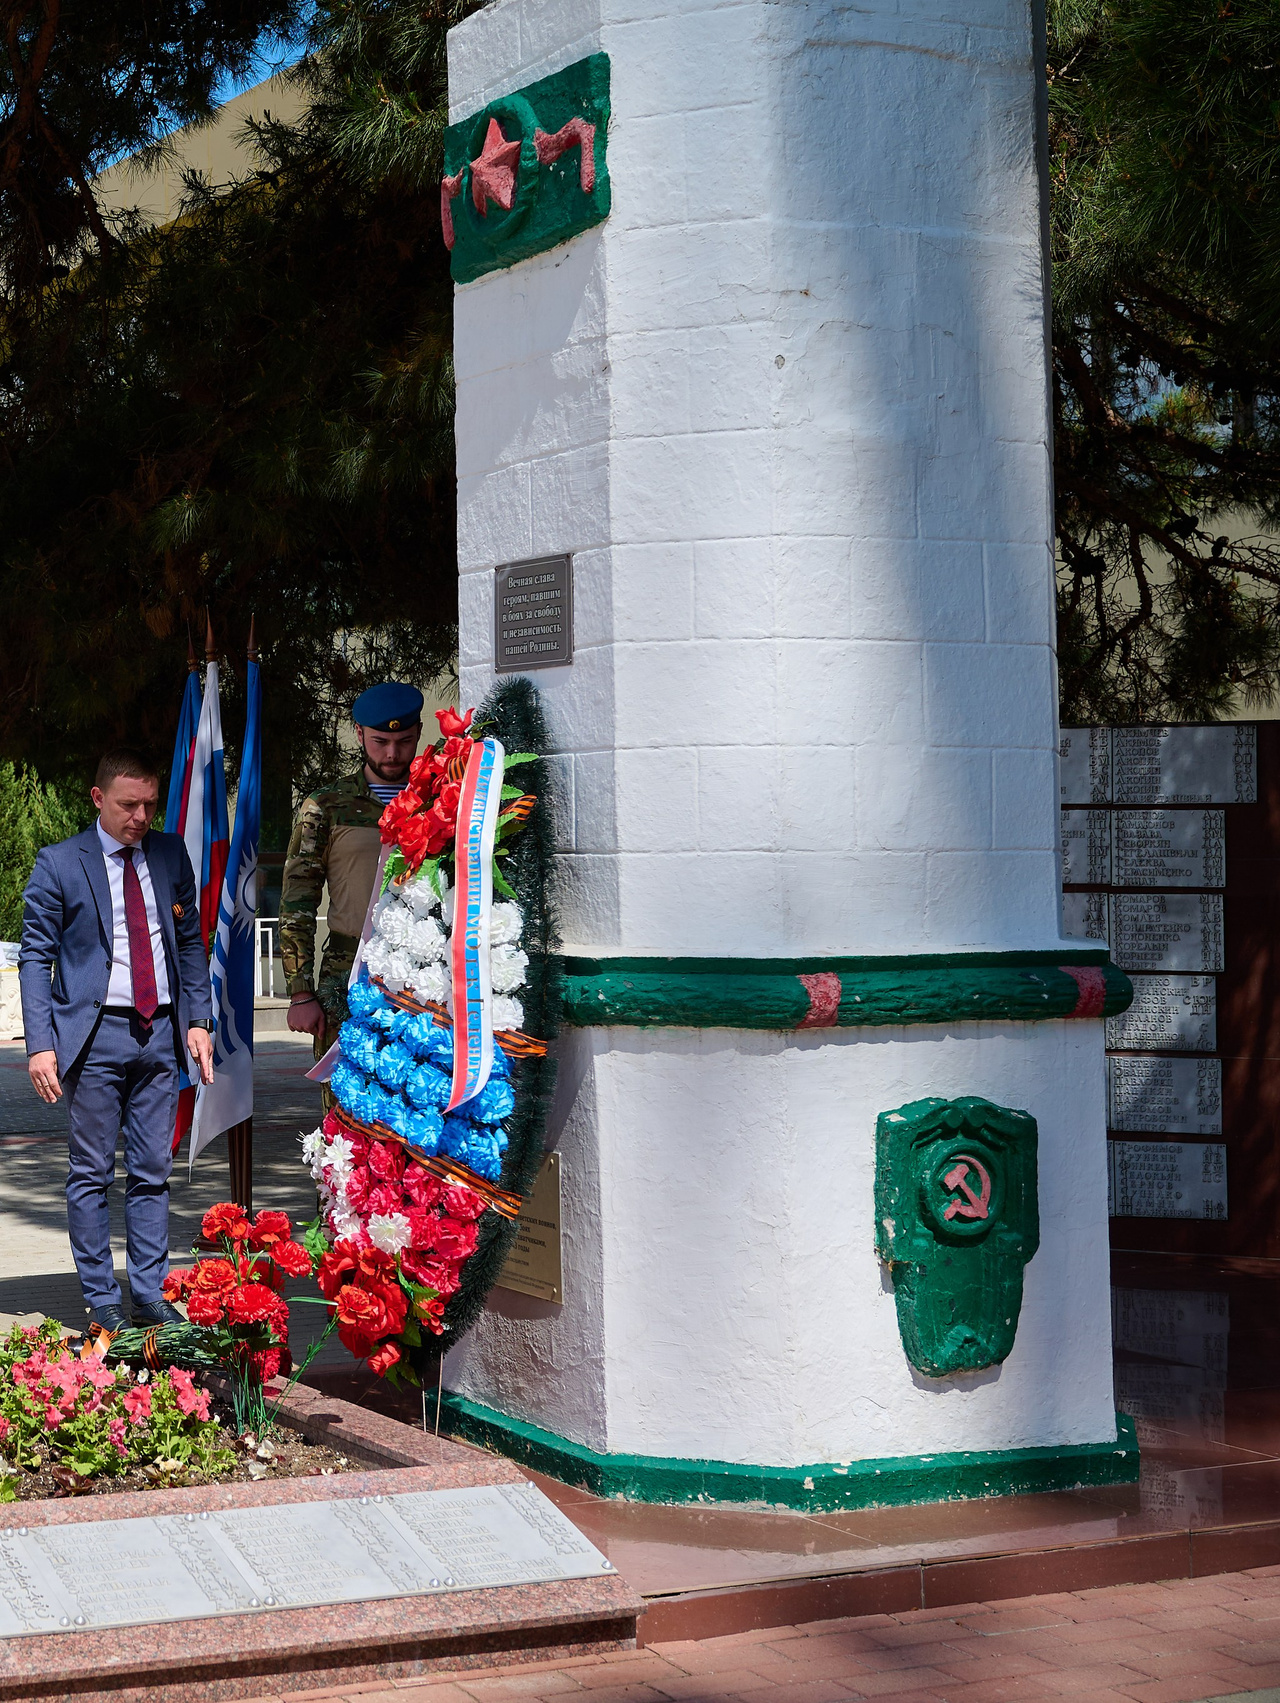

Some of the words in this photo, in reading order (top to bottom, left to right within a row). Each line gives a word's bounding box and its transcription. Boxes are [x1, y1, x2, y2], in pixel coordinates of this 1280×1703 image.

[508, 576, 533, 589] Вечная
[534, 572, 555, 585] слава
[503, 594, 530, 608] героям,
[530, 589, 561, 602] павшим
[502, 613, 507, 623] в
[508, 610, 524, 622] боях
[524, 609, 533, 620] за
[534, 603, 562, 619] свободу
[503, 629, 508, 640] и
[509, 624, 562, 638] независимость
[505, 643, 528, 656] нашей
[529, 640, 560, 655] Родины.
[464, 764, 495, 905] Администрации
[1114, 895, 1166, 904] КОМАРОВ
[1114, 904, 1167, 913] КОМАРОВ
[443, 1557, 559, 1576] НЕИЗВЕСТНЫЙ
[451, 1566, 567, 1585] НЕИЗВЕСТНЫЙ
